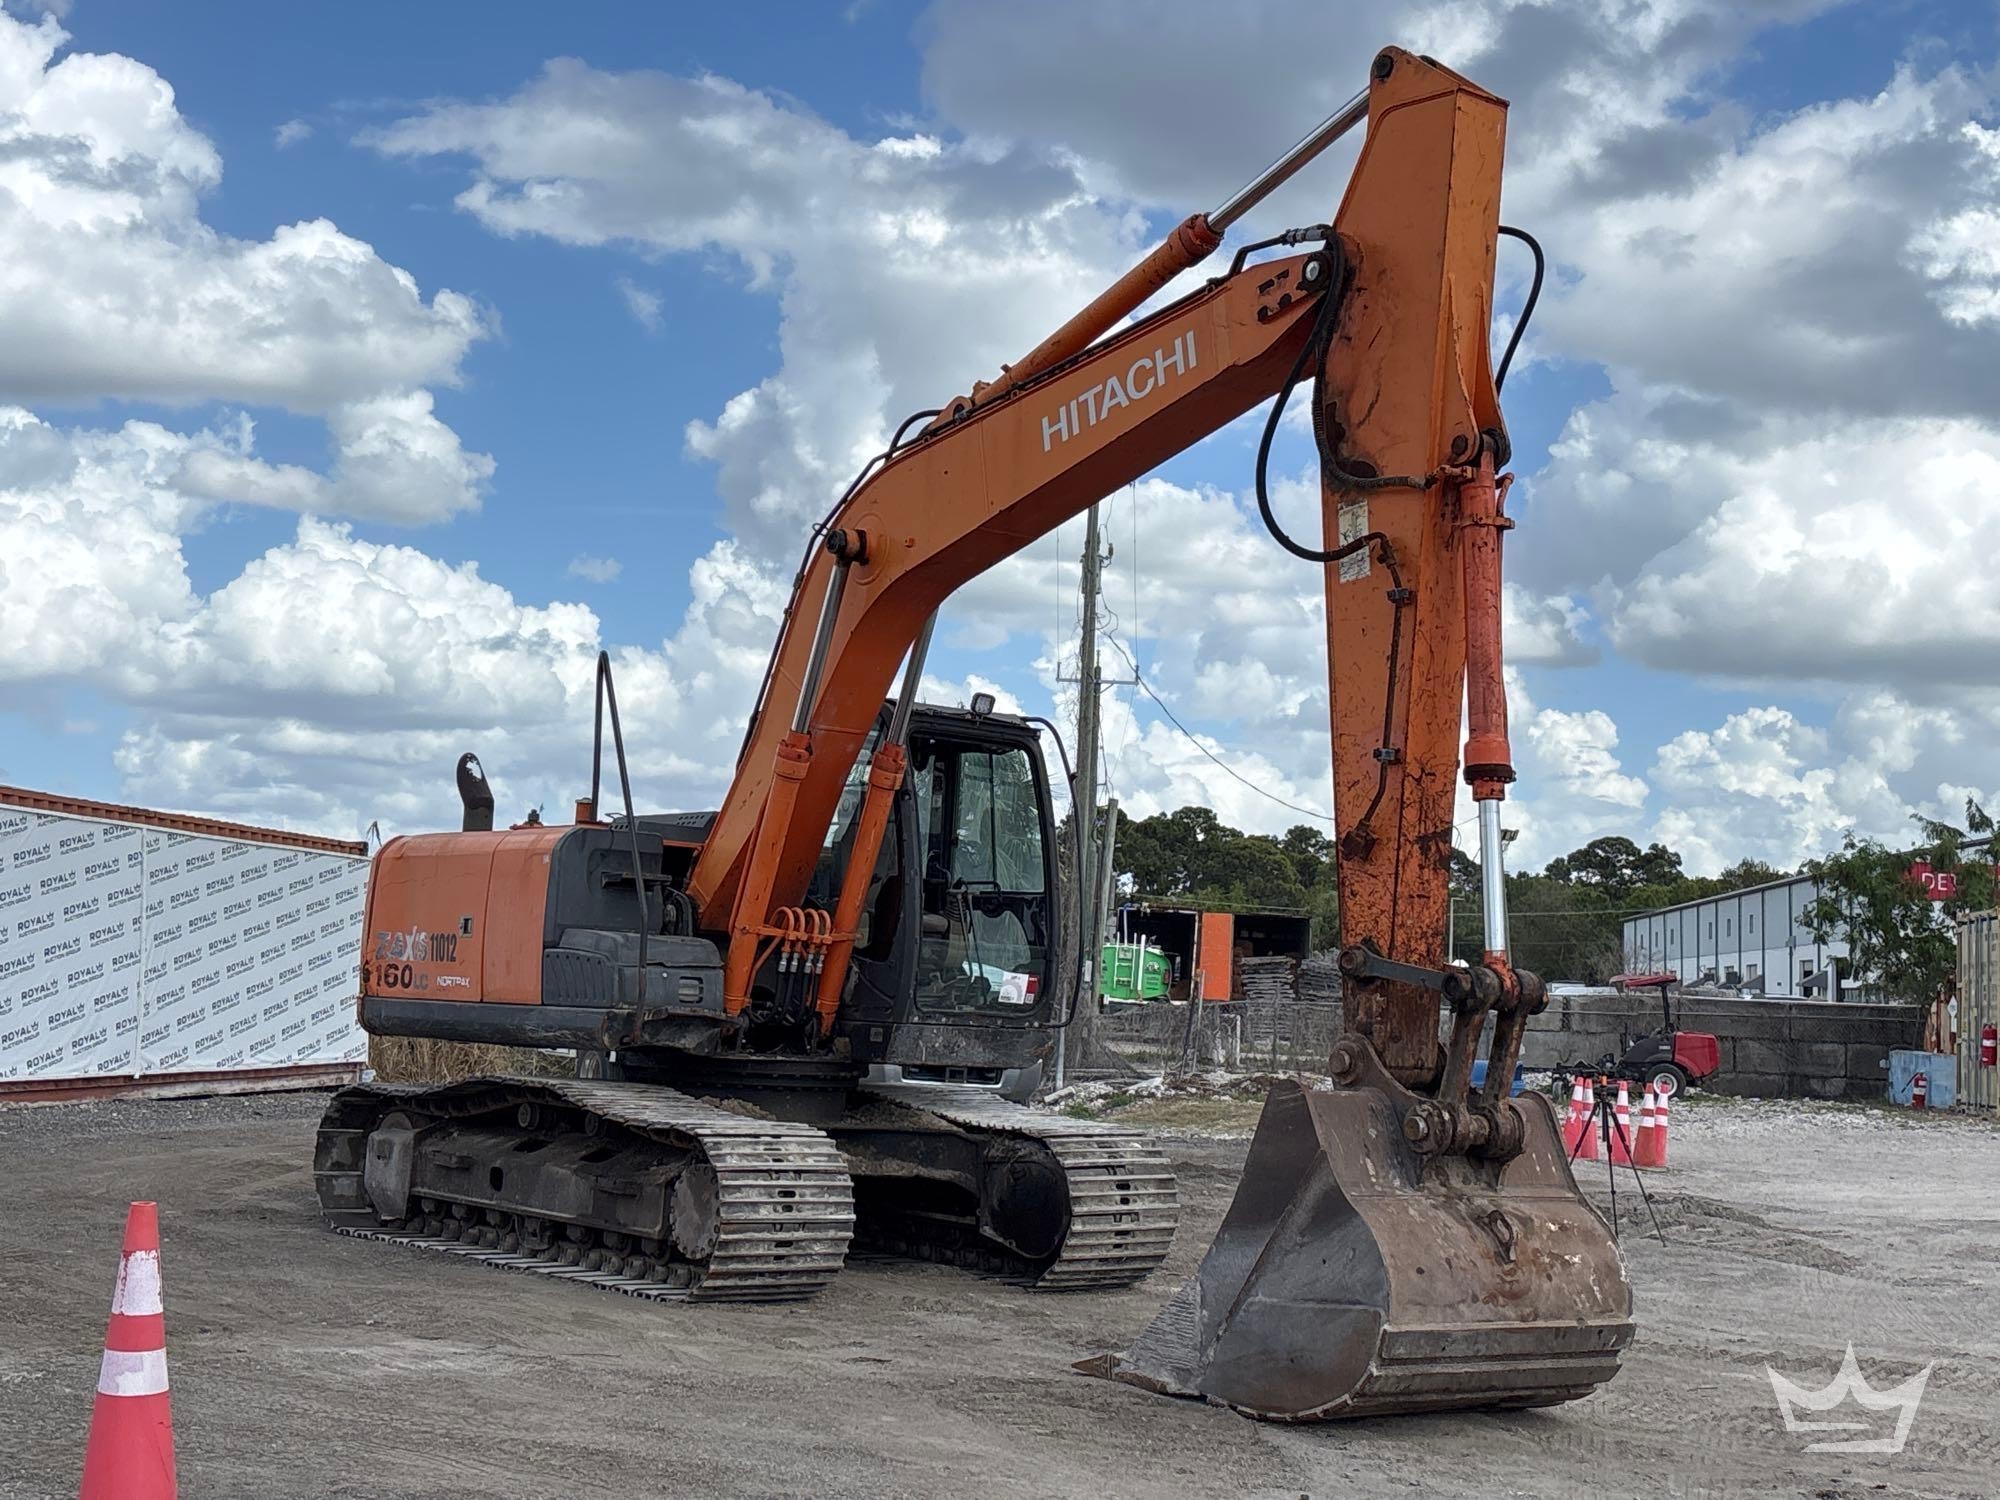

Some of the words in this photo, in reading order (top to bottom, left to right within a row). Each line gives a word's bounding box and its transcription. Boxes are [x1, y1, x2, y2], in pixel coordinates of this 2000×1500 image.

[1042, 330, 1197, 452] HITACHI
[60, 835, 87, 848] ROYAL
[13, 846, 42, 862] ROYAL
[186, 854, 209, 867] ROYAL
[85, 862, 111, 875] ROYAL
[150, 866, 172, 879] ROYAL
[241, 866, 262, 879] ROYAL
[40, 874, 69, 888] ROYAL
[207, 878, 228, 890] ROYAL
[289, 879, 308, 890] ROYAL
[108, 887, 134, 901] ROYAL
[171, 890, 192, 903] ROYAL
[258, 889, 278, 902] ROYAL
[64, 901, 91, 915] ROYAL
[224, 901, 245, 914] ROYAL
[18, 915, 48, 931] ROYAL
[189, 914, 211, 927] ROYAL
[276, 911, 295, 923] ROYAL
[90, 924, 116, 940] ROYAL
[154, 928, 176, 941] ROYAL
[243, 922, 264, 936] ROYAL
[44, 941, 72, 956] ROYAL
[209, 937, 230, 950] ROYAL
[430, 934, 457, 962] 11012
[112, 952, 138, 966] ROYAL
[174, 951, 196, 964] ROYAL
[261, 947, 281, 959] ROYAL
[144, 966, 160, 978] OYAL
[226, 960, 249, 973] ROYAL
[68, 966, 95, 983] ROYAL
[192, 974, 213, 988] ROYAL
[21, 983, 50, 1000] ROYAL
[246, 981, 268, 994] ROYAL
[94, 991, 121, 1006] ROYAL
[157, 990, 179, 1004] ROYAL
[212, 996, 233, 1010] ROYAL
[48, 1007, 77, 1024] ROYAL
[264, 1002, 283, 1016] ROYAL
[116, 1016, 137, 1030] ROYA
[177, 1011, 200, 1026] ROYAL
[230, 1018, 251, 1032] ROYAL
[1, 1026, 31, 1043] ROYAL
[72, 1032, 99, 1049] ROYAL
[141, 1028, 163, 1043] ROYAL
[195, 1033, 217, 1048] ROYAL
[250, 1037, 271, 1052] ROYAL
[27, 1052, 55, 1069] ROYAL
[98, 1054, 123, 1071] ROYAL
[160, 1050, 182, 1065] ROYAL
[217, 1053, 237, 1067] ROYAL
